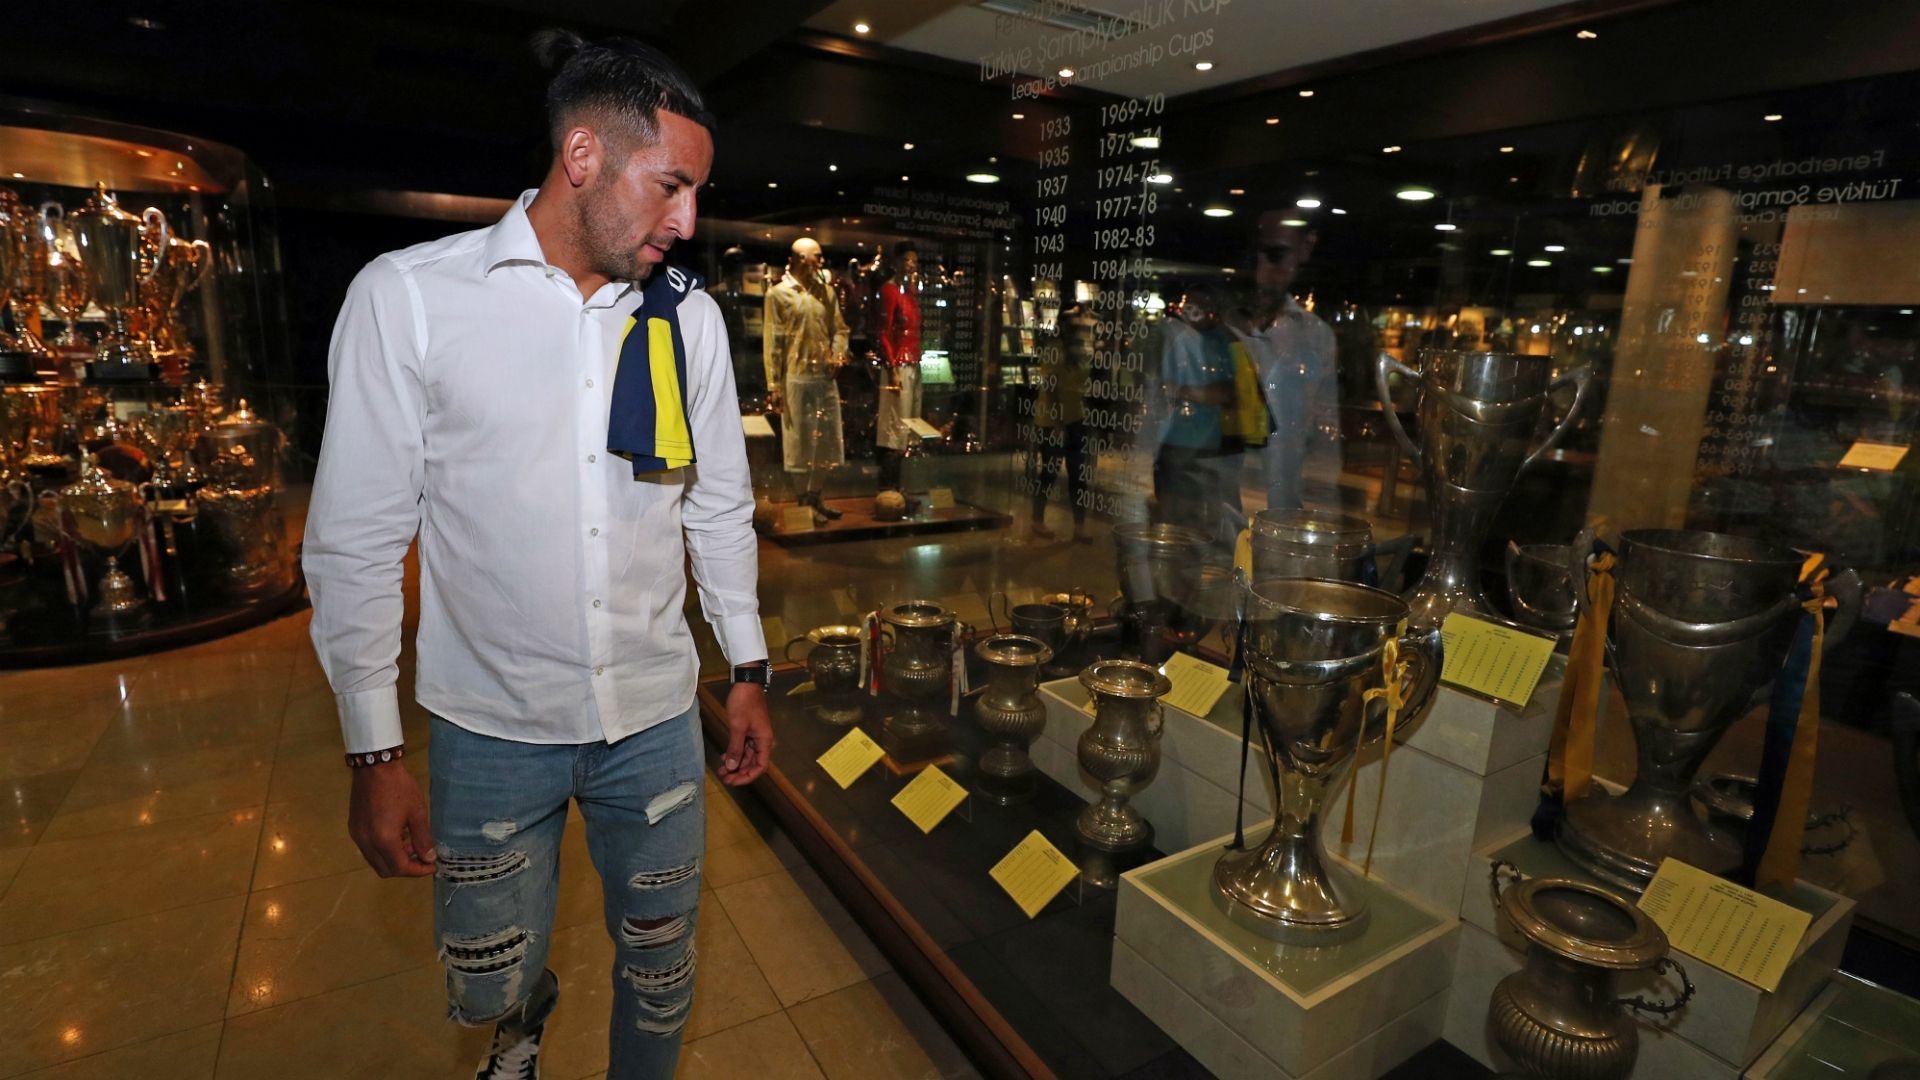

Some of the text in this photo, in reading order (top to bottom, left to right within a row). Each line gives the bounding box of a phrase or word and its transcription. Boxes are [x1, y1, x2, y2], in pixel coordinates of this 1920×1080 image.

[1011, 27, 1215, 100] League Championship Cups
[1101, 92, 1165, 127] 1969-70
[1040, 115, 1071, 141] 1933
[1038, 145, 1070, 170] 1935
[1036, 174, 1068, 198] 1937
[1097, 159, 1161, 190] 1974-75
[1035, 204, 1067, 227] 1940
[1095, 192, 1157, 220] 1977-78
[1034, 233, 1065, 254] 1943
[1093, 224, 1156, 251] 1982-83
[1032, 262, 1063, 281] 1944
[1092, 257, 1154, 280] 1984-85
[1090, 289, 1151, 310] 1988-89
[1090, 320, 1149, 341] 1995-96
[1030, 344, 1059, 365] 1950
[1086, 350, 1144, 373] 2000-01
[1083, 376, 1145, 404] 2003-04
[1081, 408, 1145, 434] 2004-05
[1016, 423, 1065, 449] 1963-64
